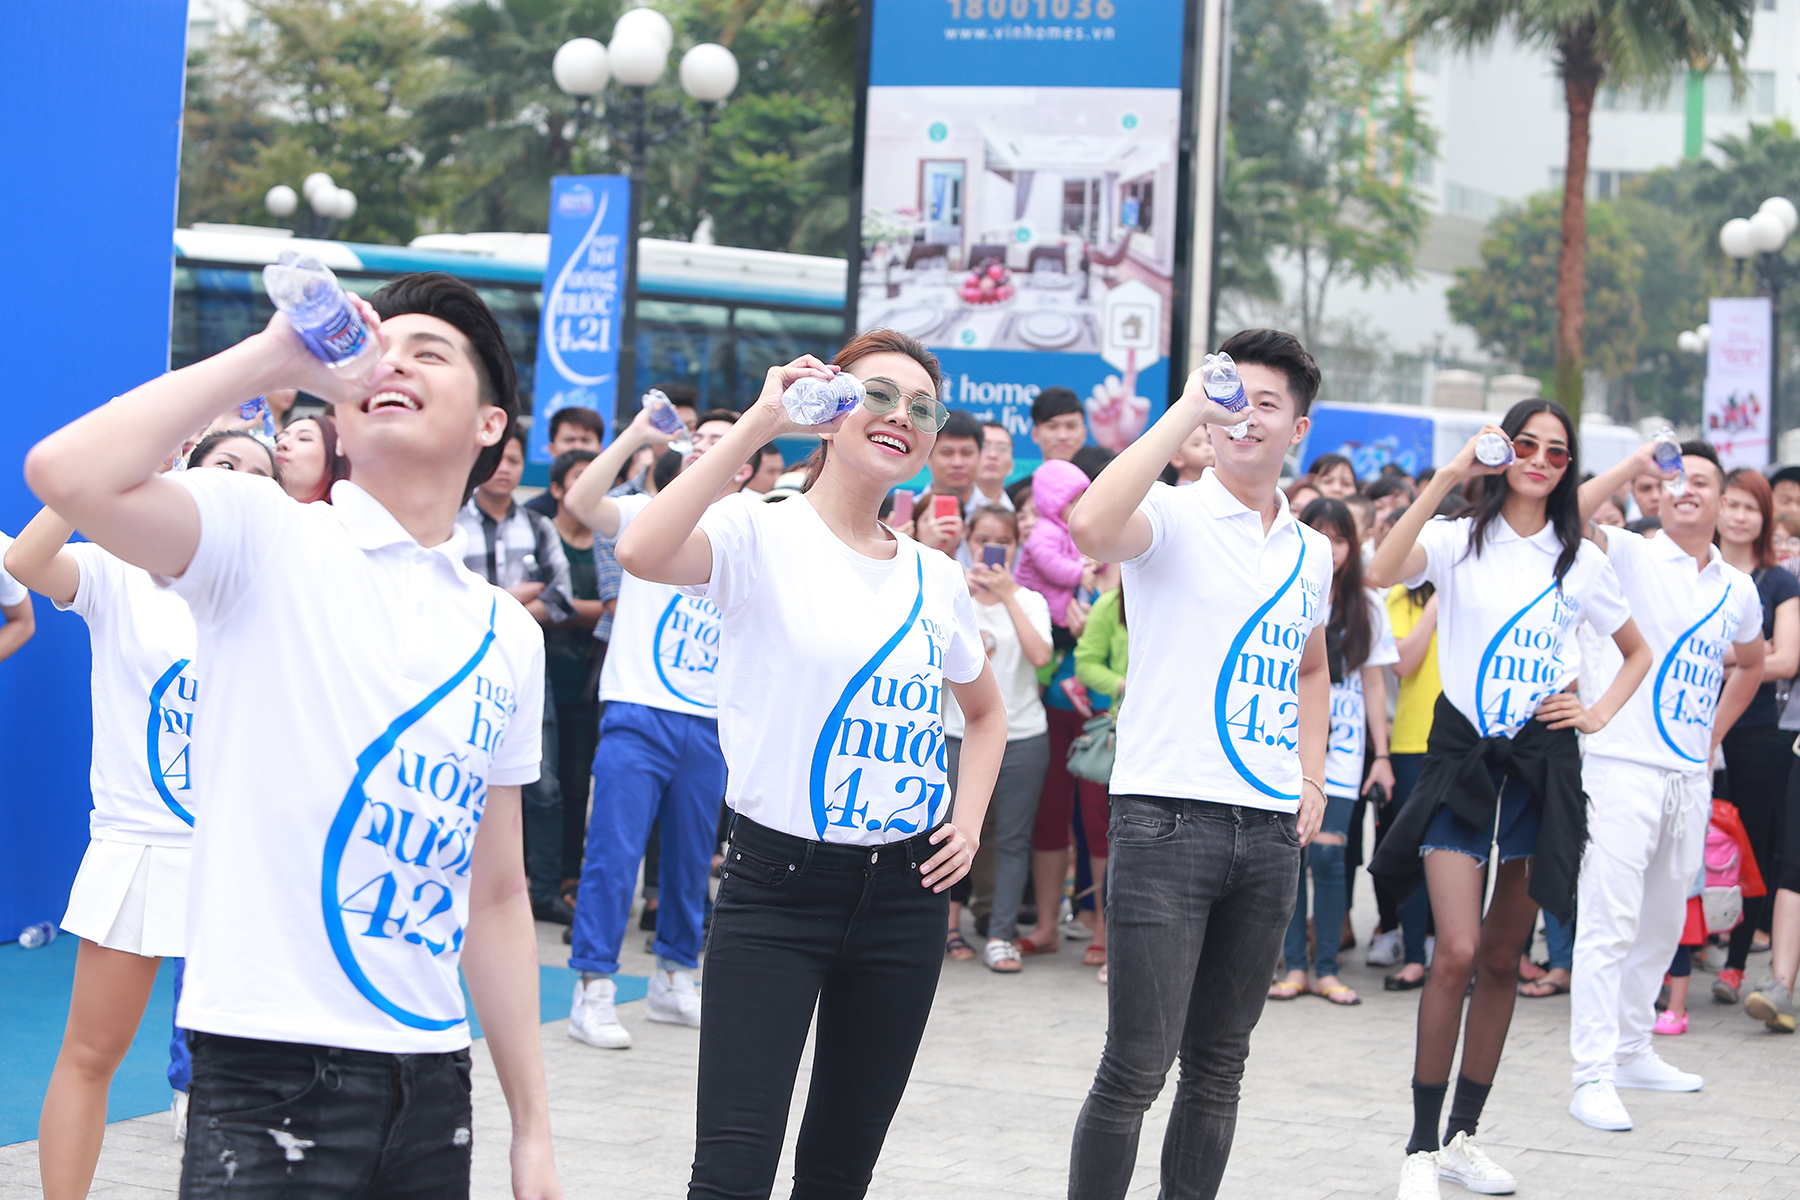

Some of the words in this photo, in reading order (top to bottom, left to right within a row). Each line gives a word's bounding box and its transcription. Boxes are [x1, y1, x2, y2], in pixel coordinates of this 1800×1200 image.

[947, 0, 1116, 19] 18001036
[944, 24, 1116, 41] www.vinhomes.vn
[554, 317, 612, 352] 4.21
[959, 373, 1042, 406] home
[824, 767, 945, 836] 4.21
